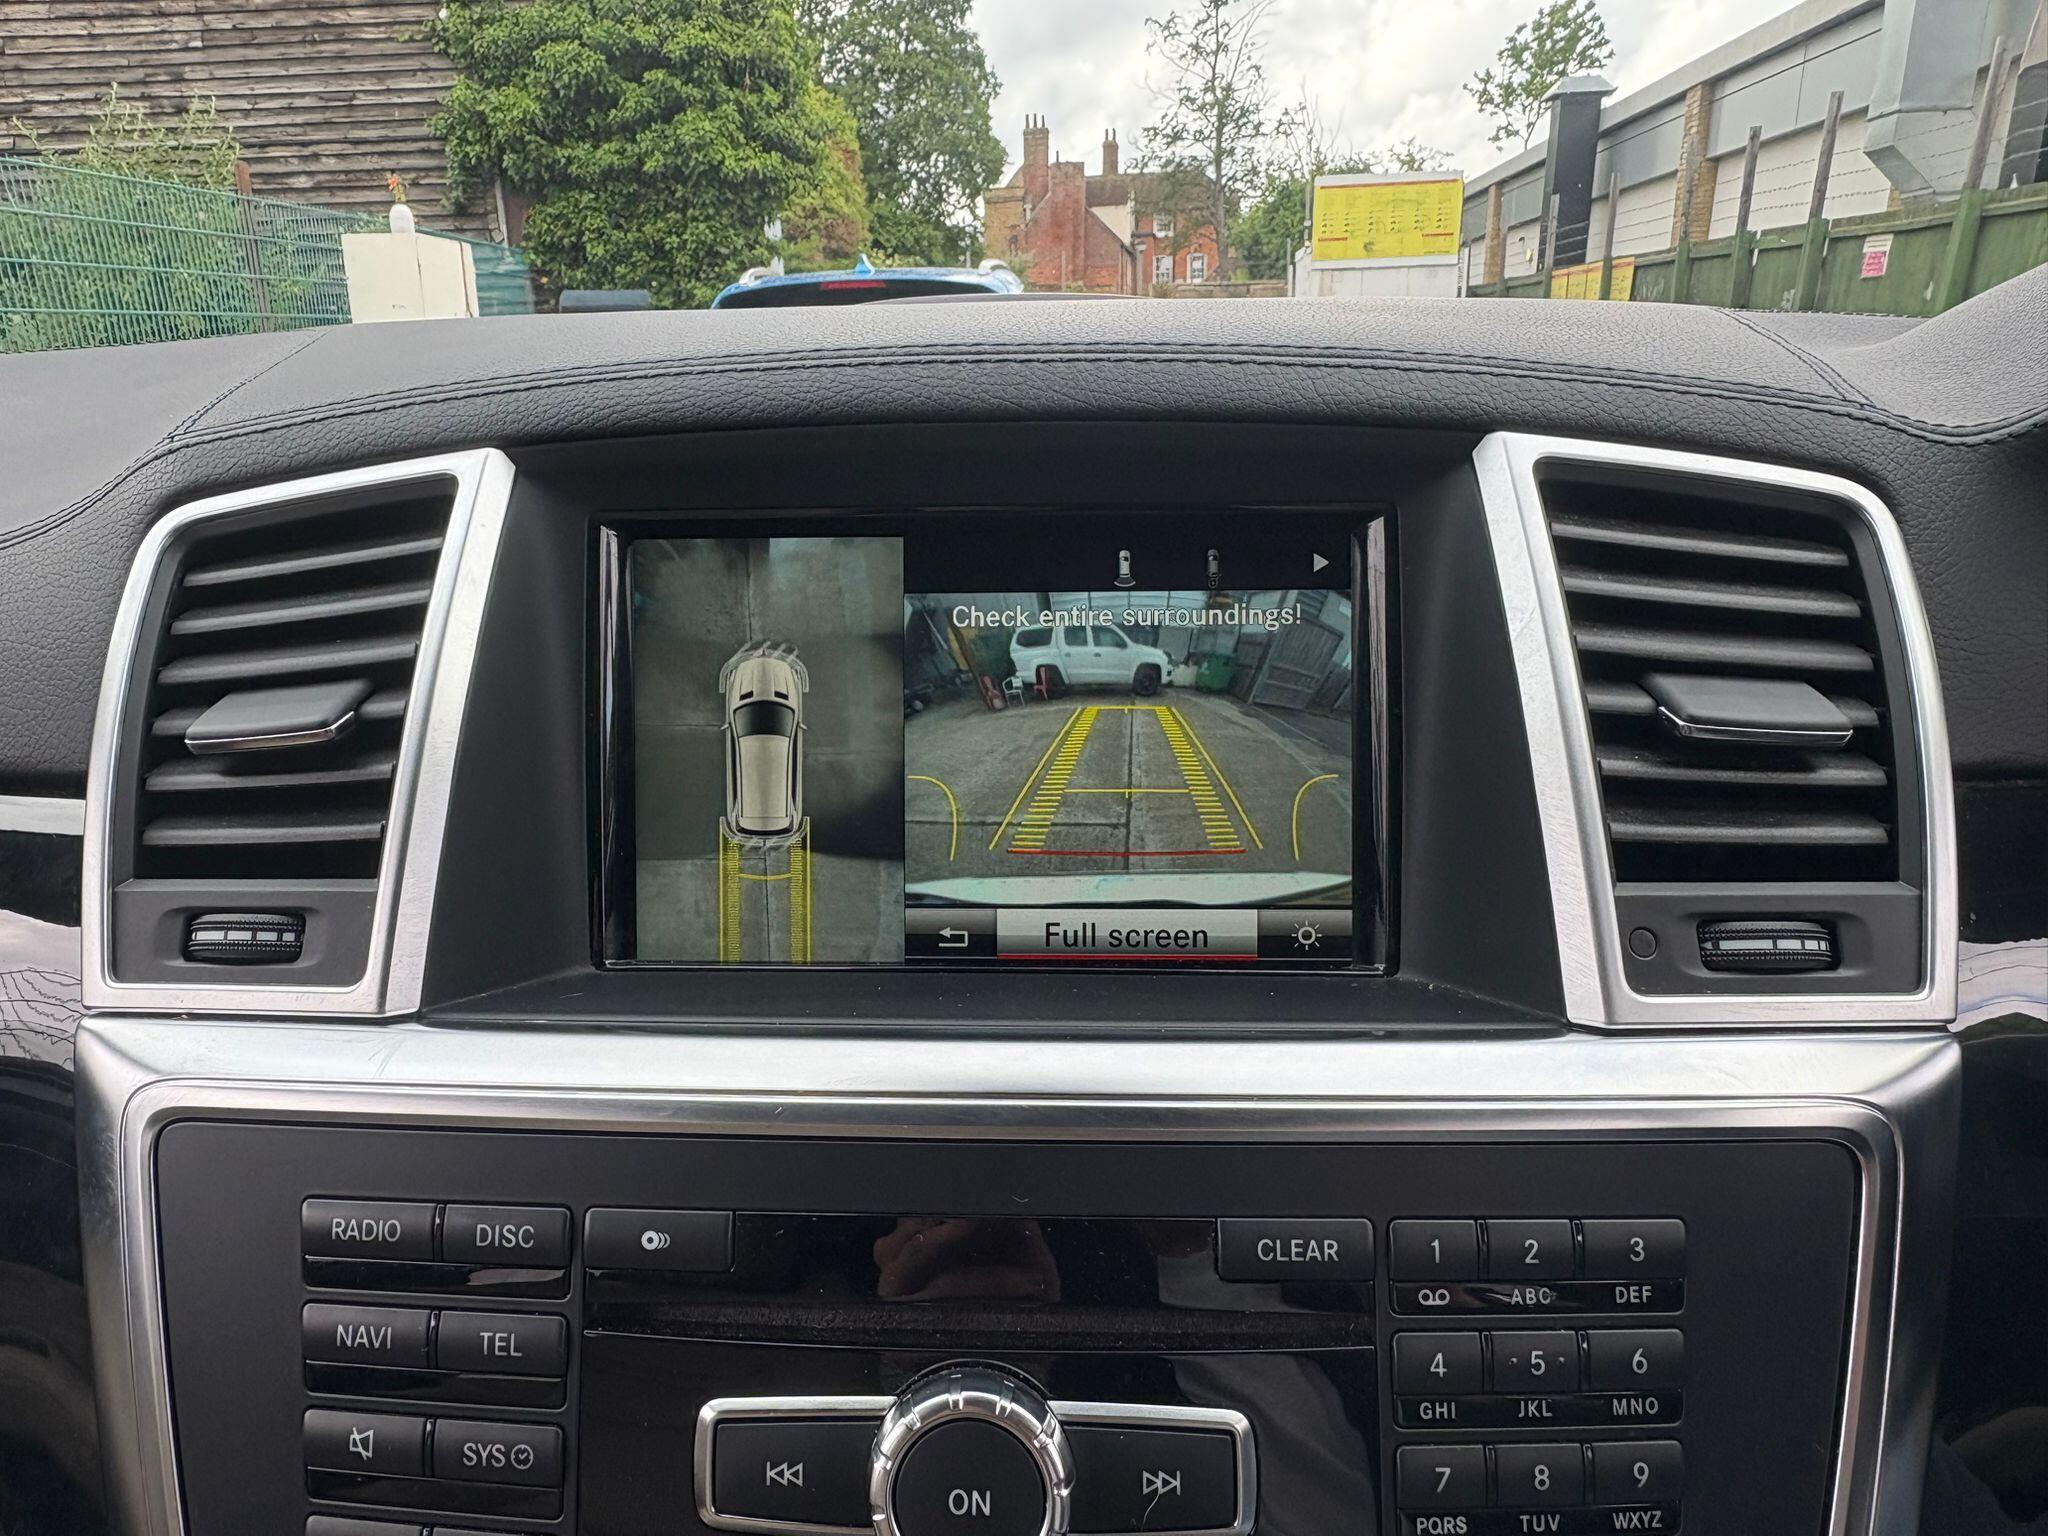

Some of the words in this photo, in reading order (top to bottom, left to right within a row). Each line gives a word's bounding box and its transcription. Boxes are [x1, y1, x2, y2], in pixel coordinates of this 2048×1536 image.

[952, 603, 1031, 628] Check
[1039, 603, 1114, 628] entire
[1122, 603, 1302, 632] surroundings!
[1045, 923, 1097, 949] Full
[1107, 928, 1209, 949] screen
[332, 1217, 401, 1243] RADIO
[476, 1223, 534, 1249] DISC
[1257, 1238, 1339, 1262] CLEAR
[1430, 1238, 1440, 1263] 1
[1524, 1239, 1540, 1264] 2
[1630, 1237, 1645, 1262] 3
[1511, 1287, 1552, 1305] ABC
[1615, 1285, 1653, 1304] DEF
[336, 1323, 392, 1350] NAVI
[480, 1332, 523, 1357] TEL
[1430, 1352, 1447, 1377] 4
[1530, 1350, 1546, 1375] 5
[1632, 1348, 1648, 1374] 6
[1419, 1401, 1457, 1420] GHI
[1518, 1399, 1553, 1418] JKL
[1612, 1396, 1659, 1416] MNO
[463, 1442, 506, 1467] SYS
[1435, 1467, 1451, 1493] 7
[1534, 1464, 1550, 1491] 8
[1633, 1461, 1649, 1488] 9
[948, 1488, 991, 1516] ON
[1416, 1516, 1468, 1536] PQRS
[1519, 1514, 1561, 1533] TUV
[1612, 1510, 1663, 1530] WXYZ
